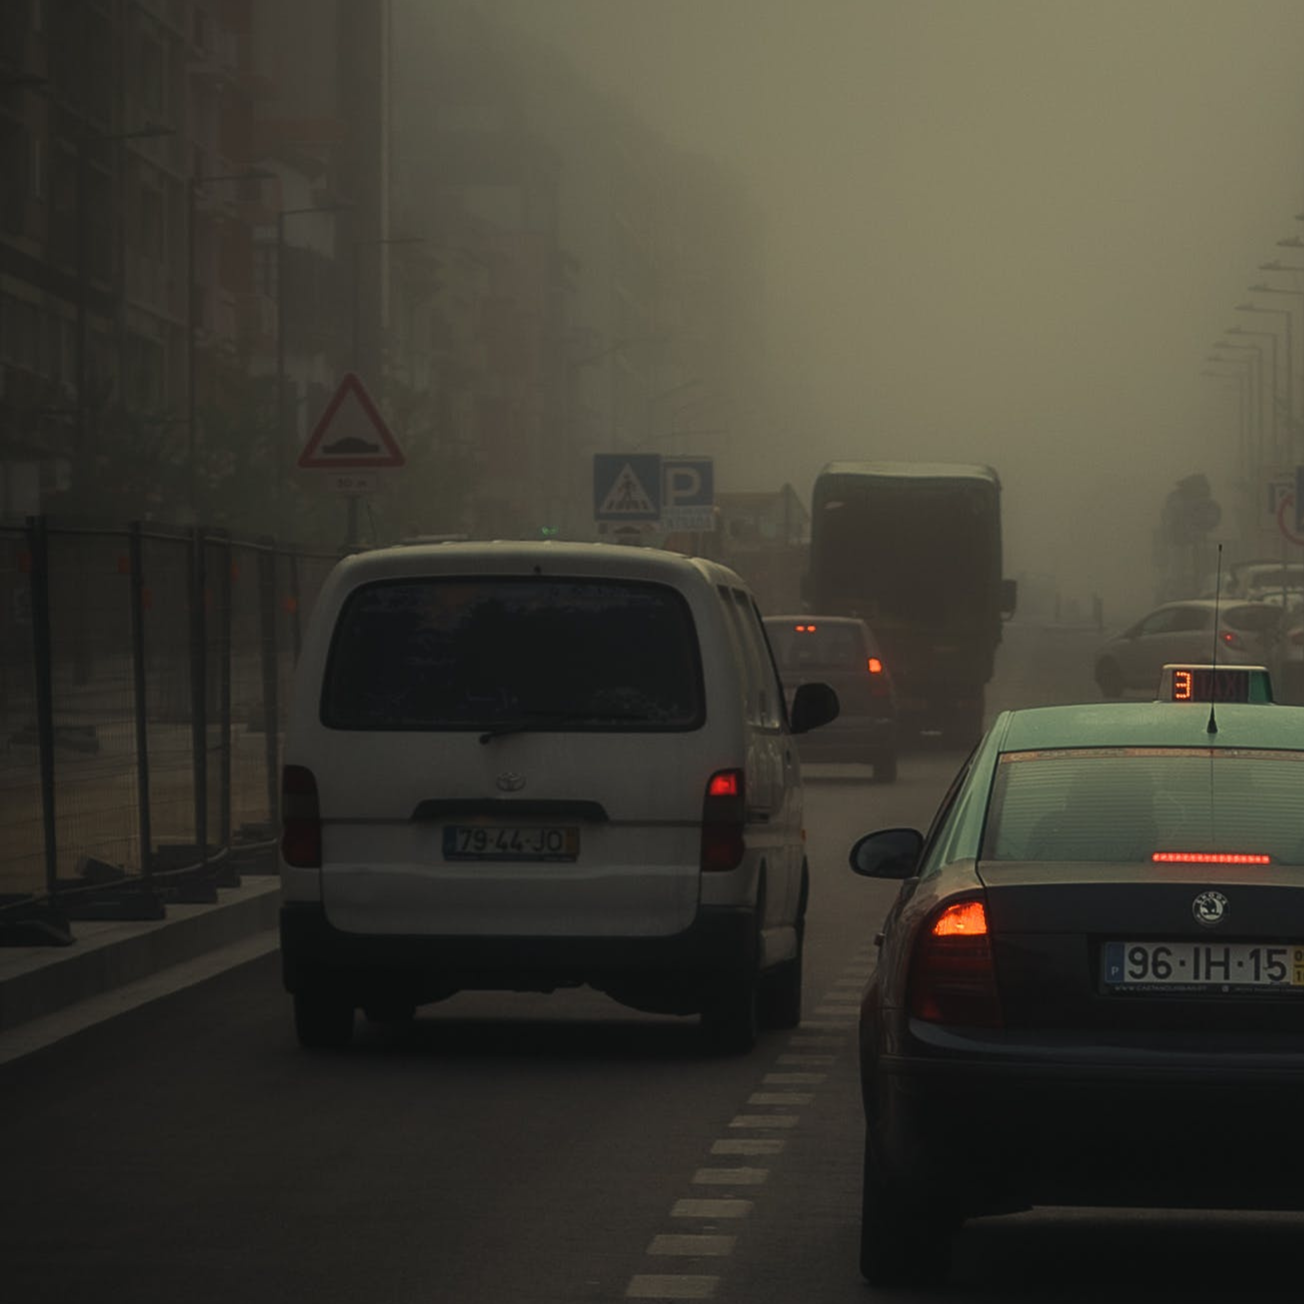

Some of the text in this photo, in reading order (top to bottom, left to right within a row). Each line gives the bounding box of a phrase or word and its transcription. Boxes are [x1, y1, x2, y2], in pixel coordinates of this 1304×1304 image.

[665, 466, 702, 507] P
[1174, 670, 1192, 700] 3
[1195, 671, 1246, 700] TAXI
[1110, 966, 1120, 976] P
